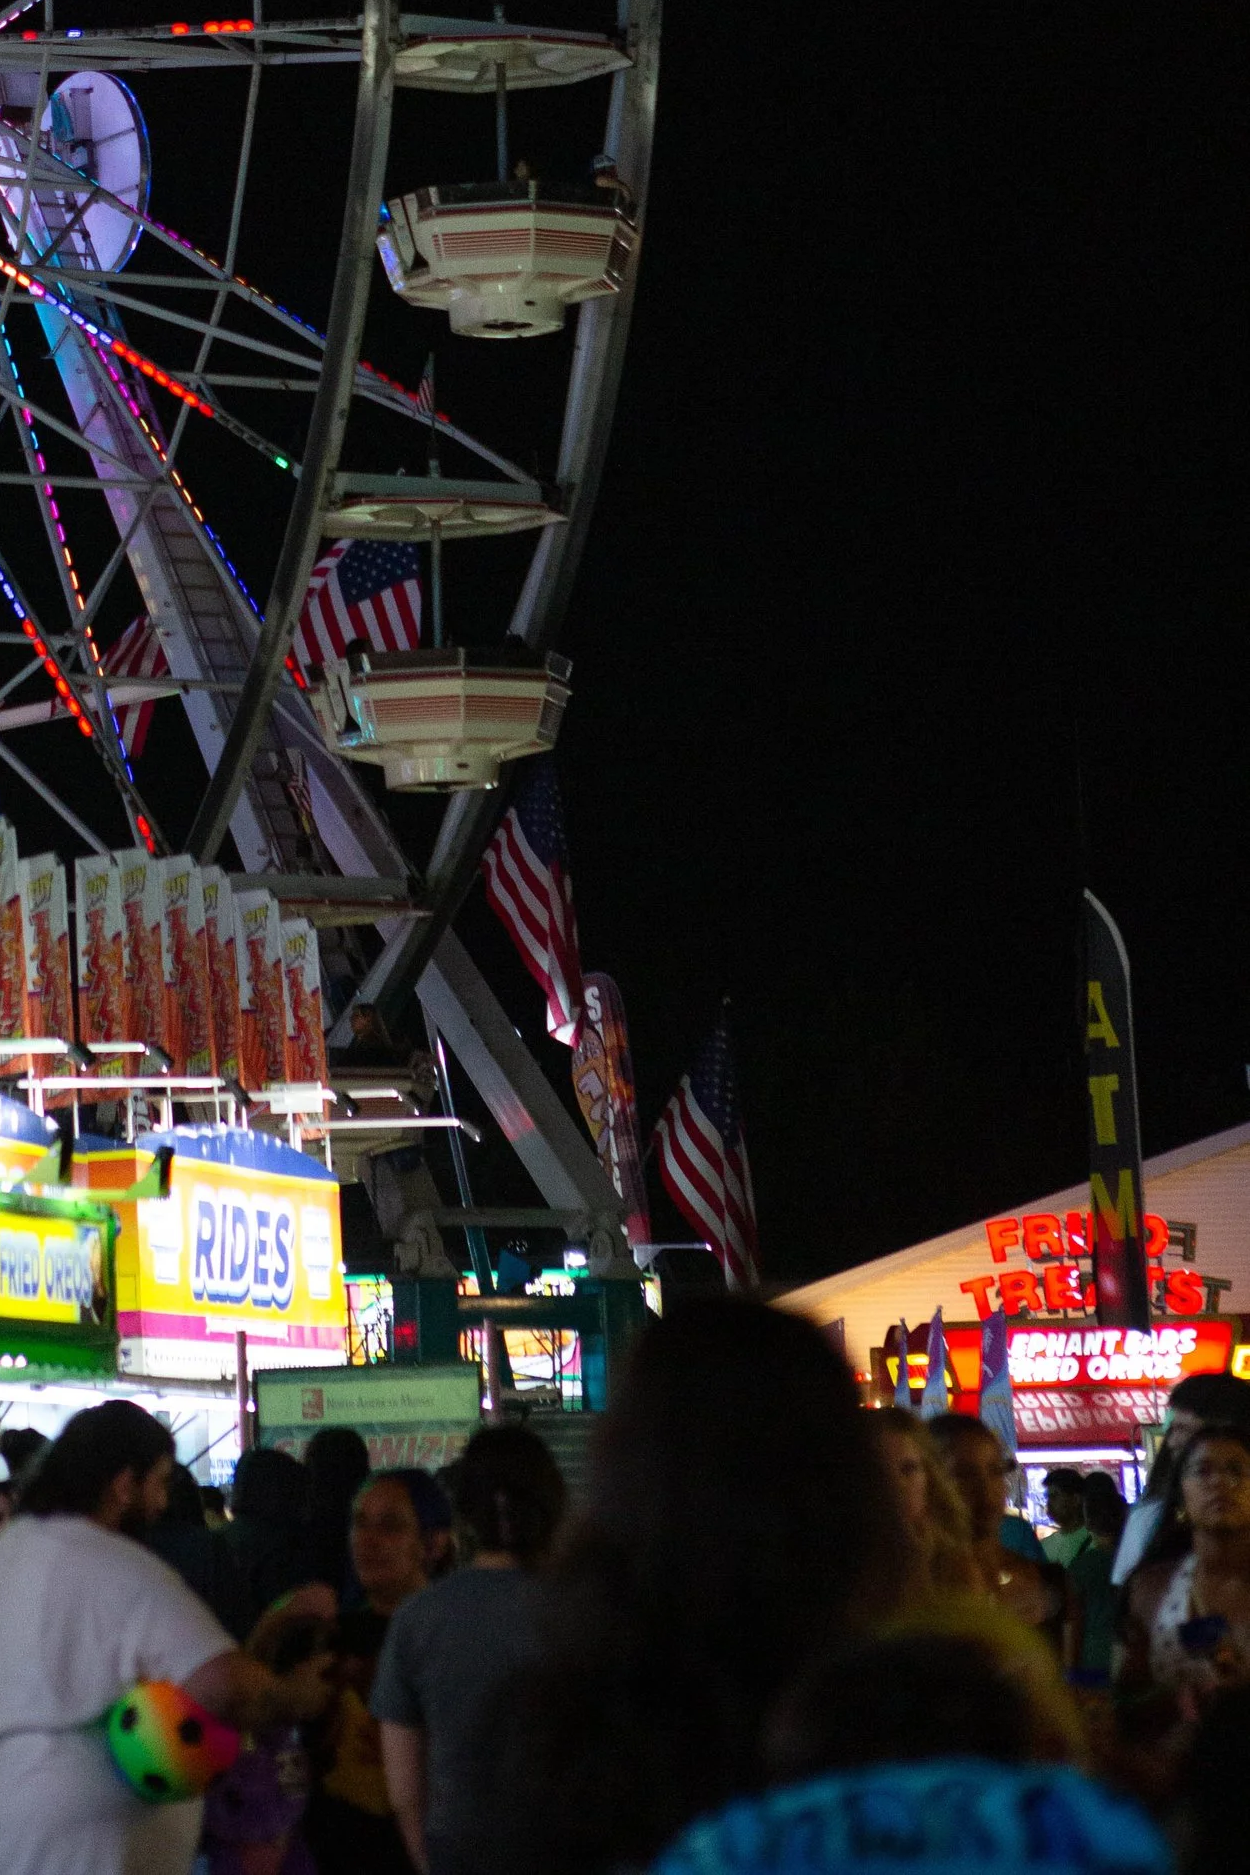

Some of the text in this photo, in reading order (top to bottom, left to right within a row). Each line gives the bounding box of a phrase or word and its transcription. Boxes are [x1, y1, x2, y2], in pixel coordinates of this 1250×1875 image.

[1086, 979, 1138, 1242] ATM
[193, 1198, 293, 1311] RIDES
[985, 1212, 1170, 1263] FRID
[44, 1235, 94, 1304] OREOS
[959, 1265, 1204, 1321] TRES
[1008, 1330, 1122, 1358] EPHANT
